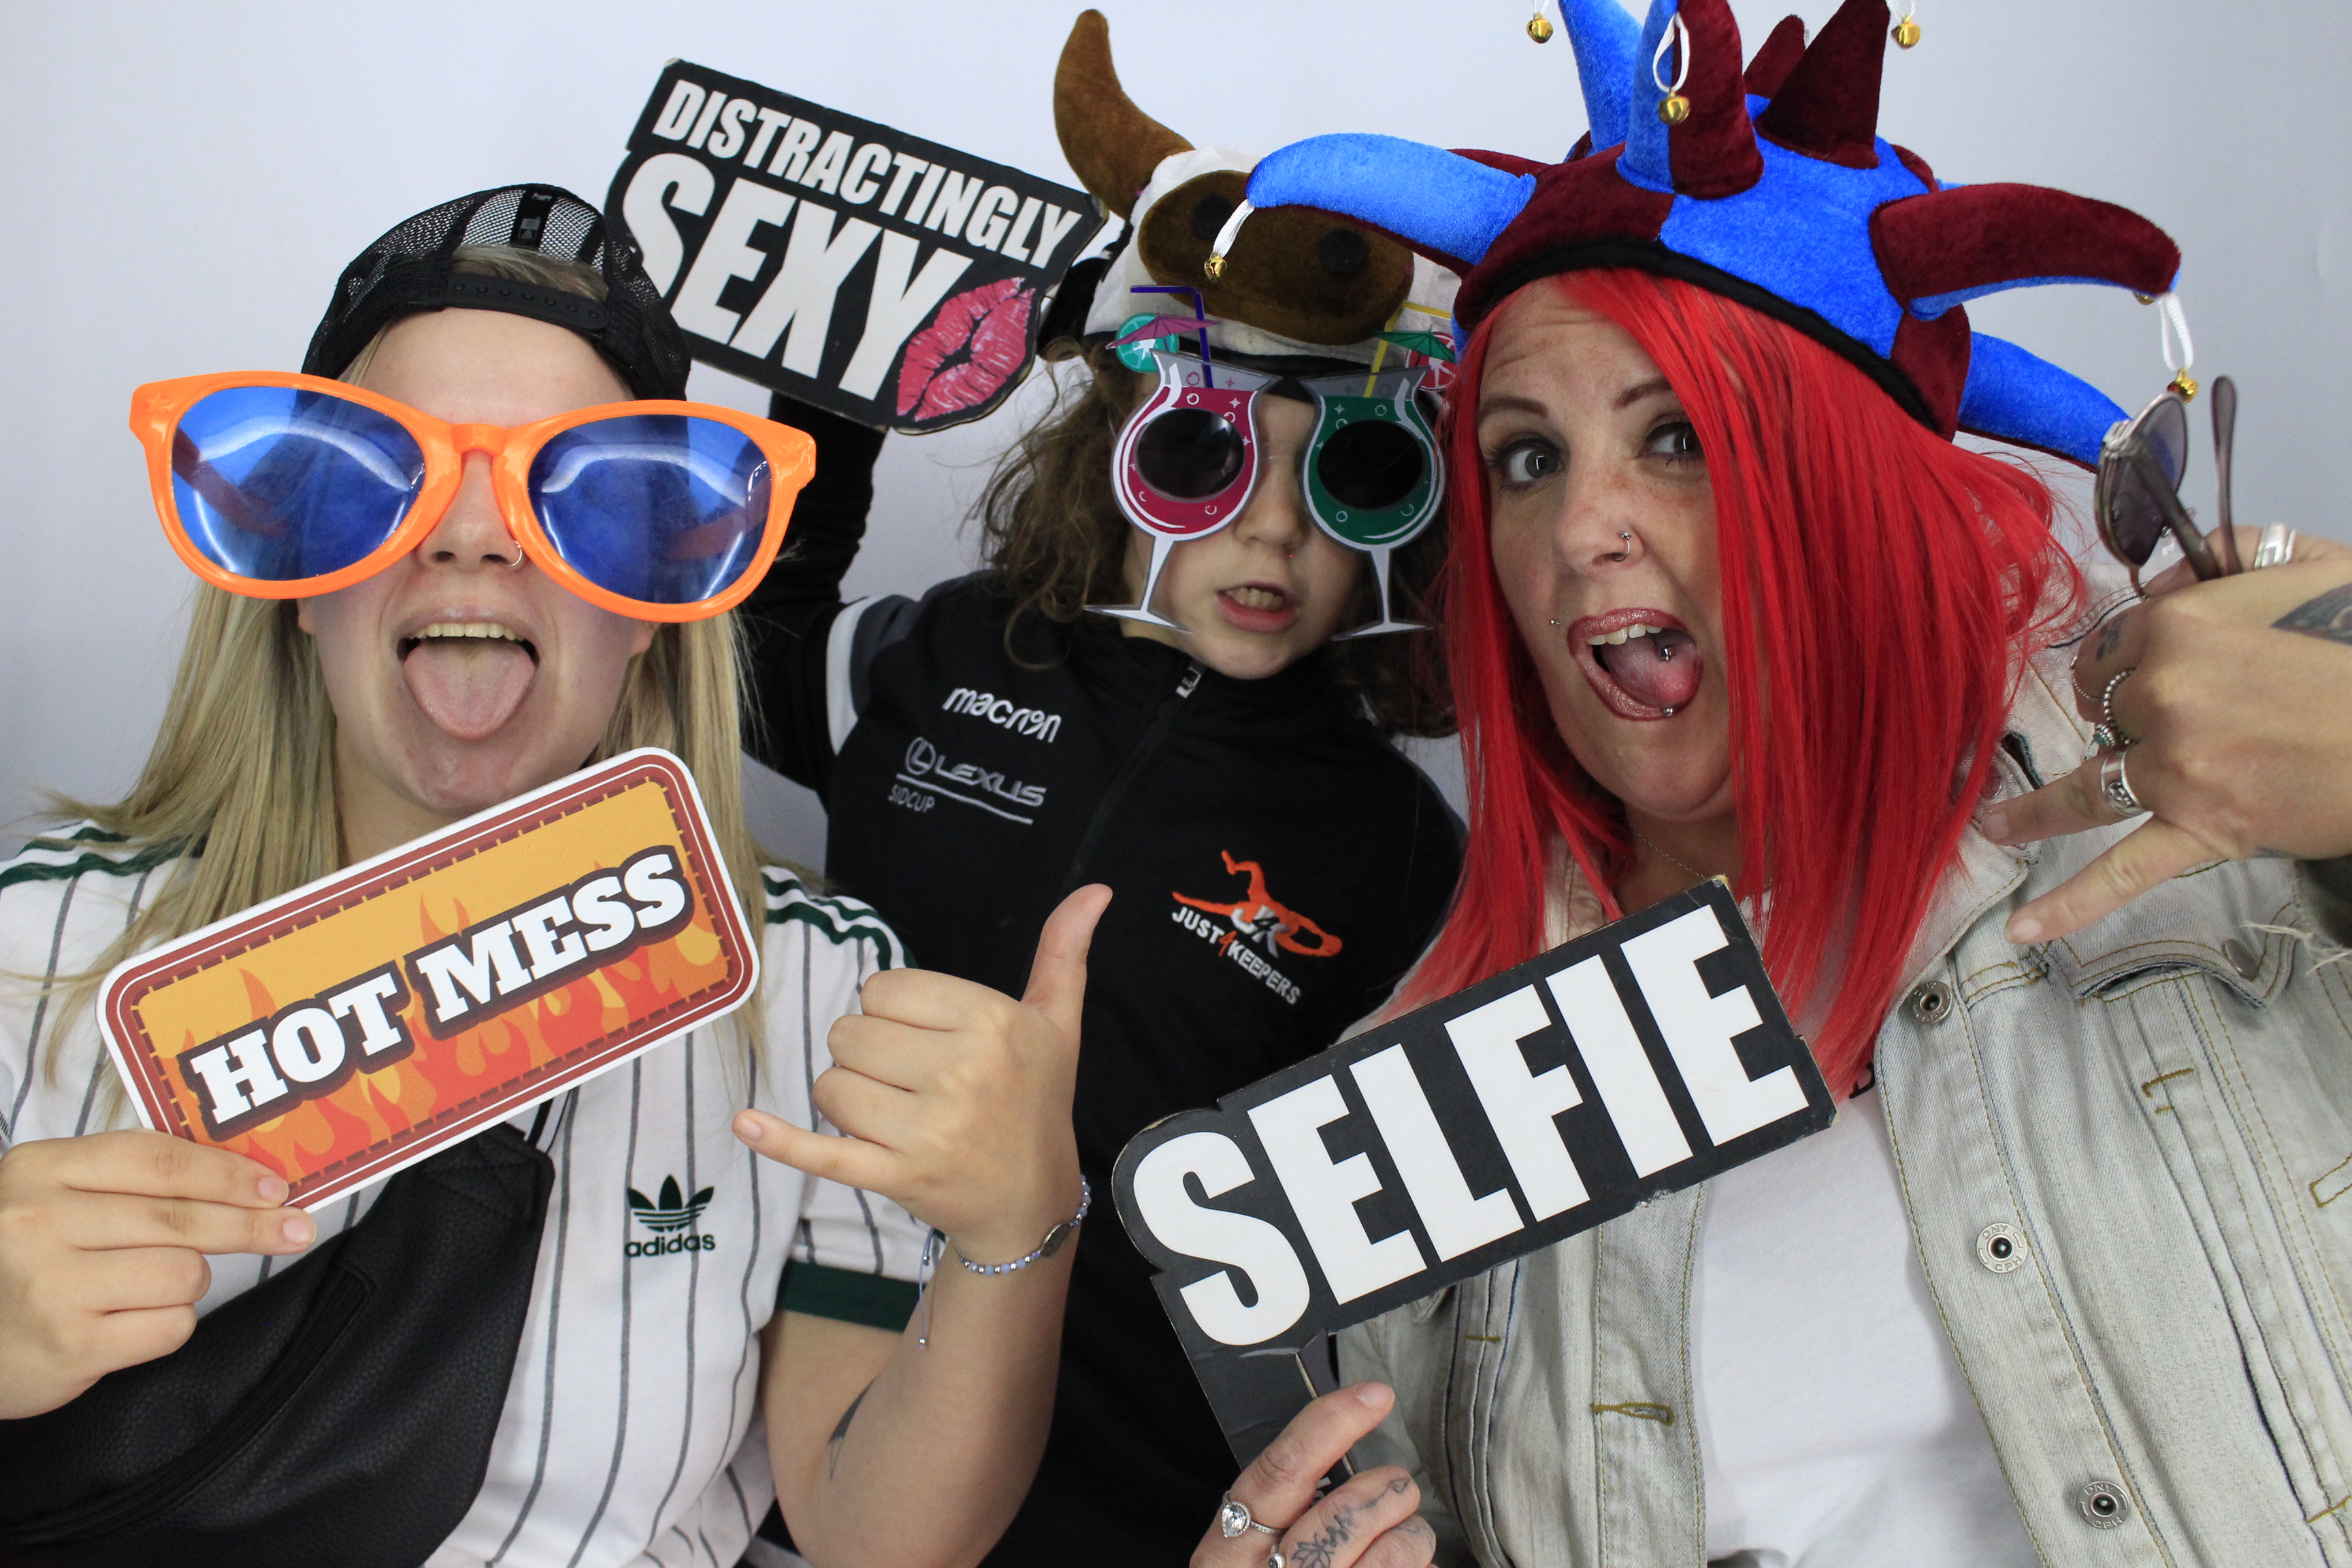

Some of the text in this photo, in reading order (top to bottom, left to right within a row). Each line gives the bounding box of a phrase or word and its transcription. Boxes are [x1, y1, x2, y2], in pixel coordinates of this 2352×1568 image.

[651, 79, 1083, 269] DISTRACTINGLY
[622, 152, 975, 401] SEXY
[942, 687, 1062, 743] macron
[887, 783, 936, 813] SIDCUP
[934, 754, 1047, 807] LEXUS
[191, 853, 686, 1124] HOT MESS
[1132, 904, 1810, 1346] SELFIE
[625, 1233, 716, 1258] adidas
